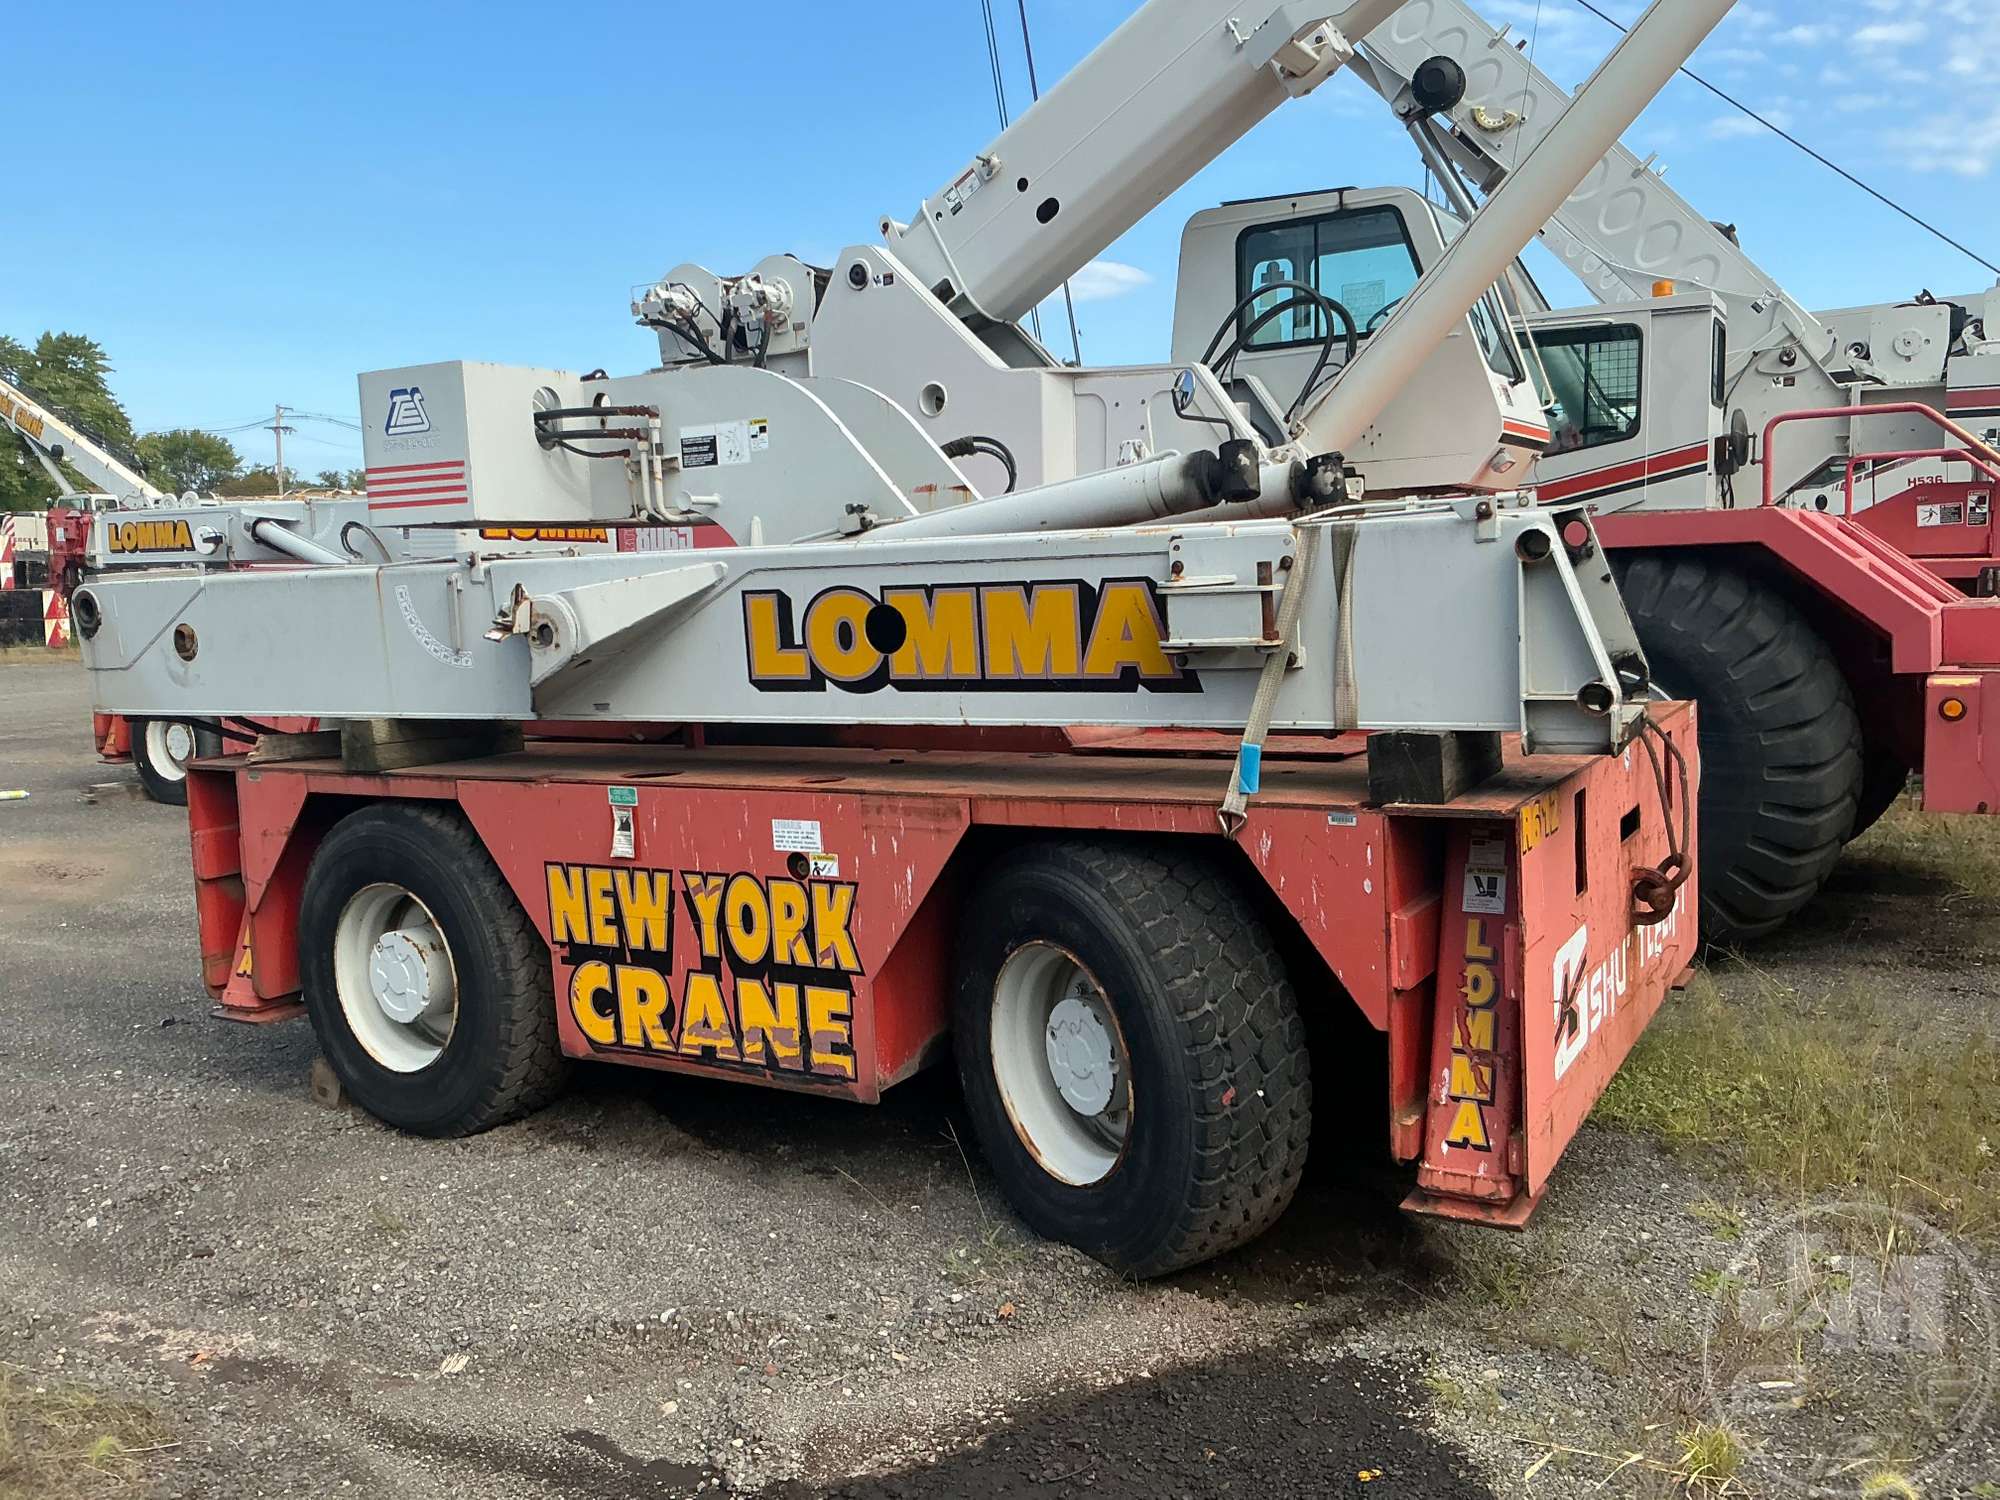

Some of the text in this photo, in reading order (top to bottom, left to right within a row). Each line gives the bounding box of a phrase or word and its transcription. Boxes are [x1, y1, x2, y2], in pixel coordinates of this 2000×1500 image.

[108, 520, 196, 553] LOMMA
[742, 577, 1204, 694] LOMMA
[544, 861, 866, 976] NEW YORK
[569, 960, 858, 1082] CRANE
[1445, 918, 1503, 1152] LOMMA
